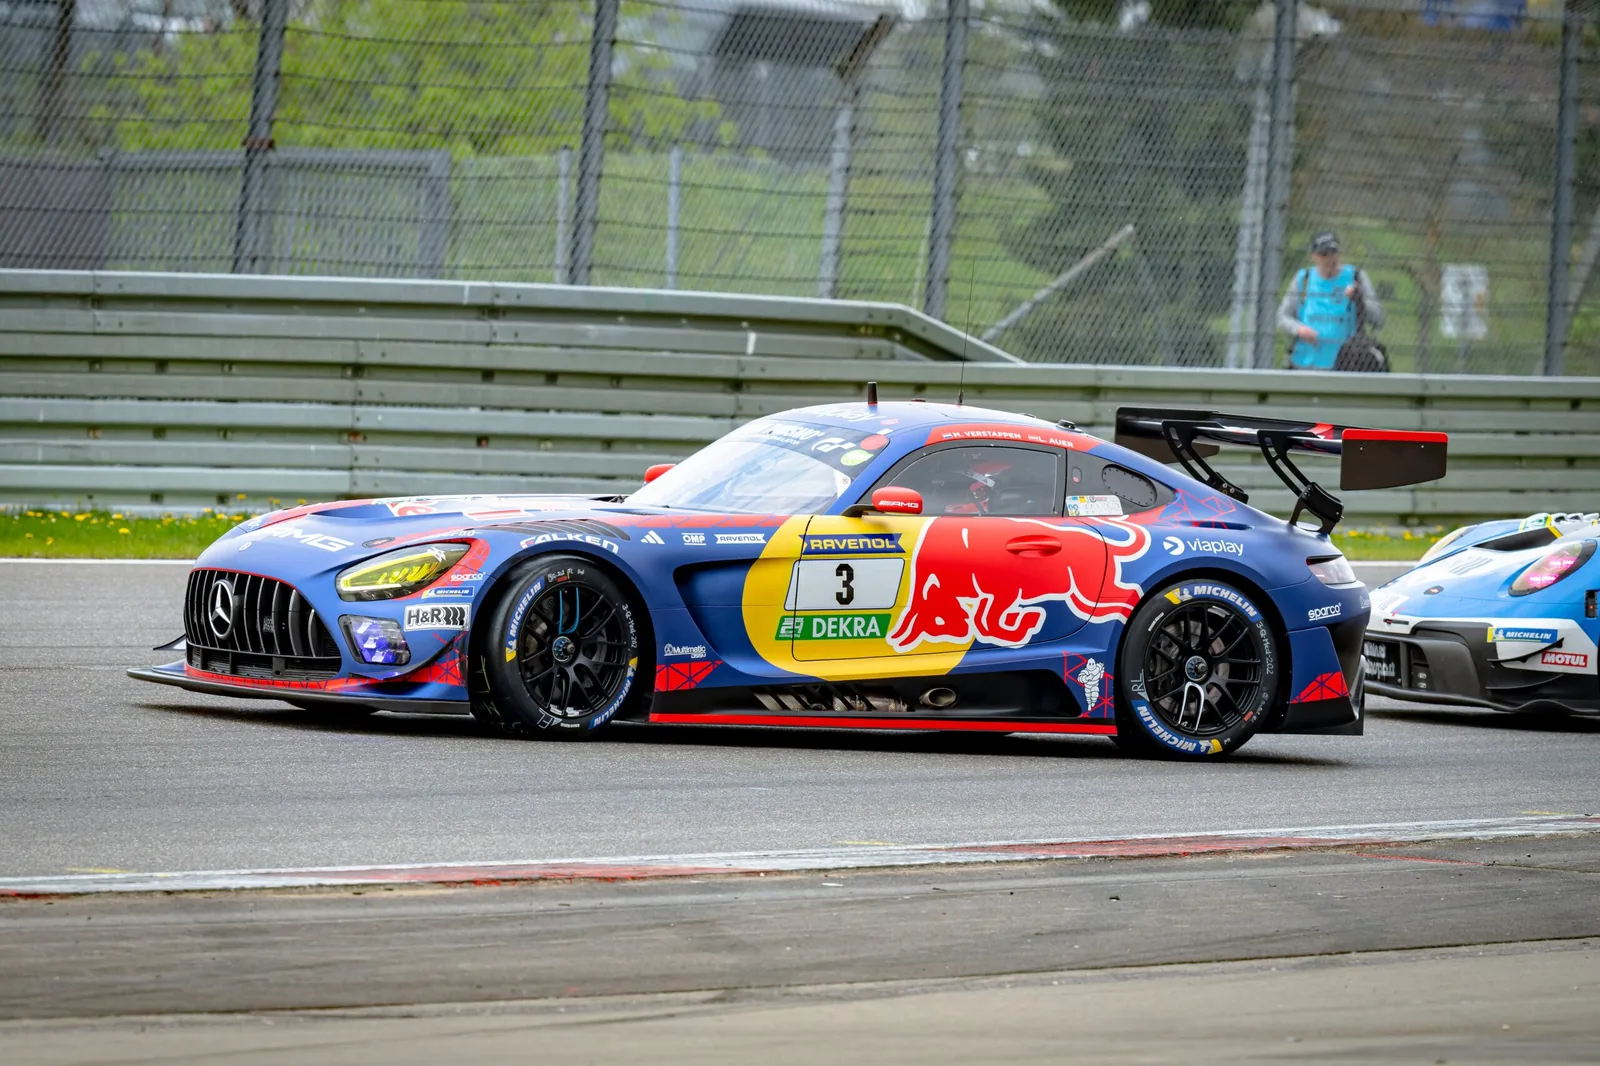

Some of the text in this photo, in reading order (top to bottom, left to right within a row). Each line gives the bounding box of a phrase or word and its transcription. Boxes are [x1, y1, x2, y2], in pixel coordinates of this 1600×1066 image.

[962, 431, 1021, 439] VERSTAPPEN
[1049, 438, 1074, 448] AUER
[519, 532, 619, 554] FALKEN
[682, 534, 706, 544] OMP
[719, 535, 762, 543] RAVENOL
[810, 537, 897, 550] RAVENOL
[1186, 538, 1244, 556] viaplay
[450, 572, 484, 582] sparco
[835, 563, 855, 606] 3
[1193, 585, 1258, 617] MICHELIN
[407, 607, 441, 626] H&R
[509, 581, 542, 638] MICHELIN
[1308, 604, 1341, 619] sparco
[812, 616, 881, 638] DEKRA
[1505, 631, 1552, 640] MICHELIN
[1543, 653, 1586, 666] MOTUL
[593, 679, 632, 728] MICHELIN
[1136, 705, 1198, 753] MICHELIN
